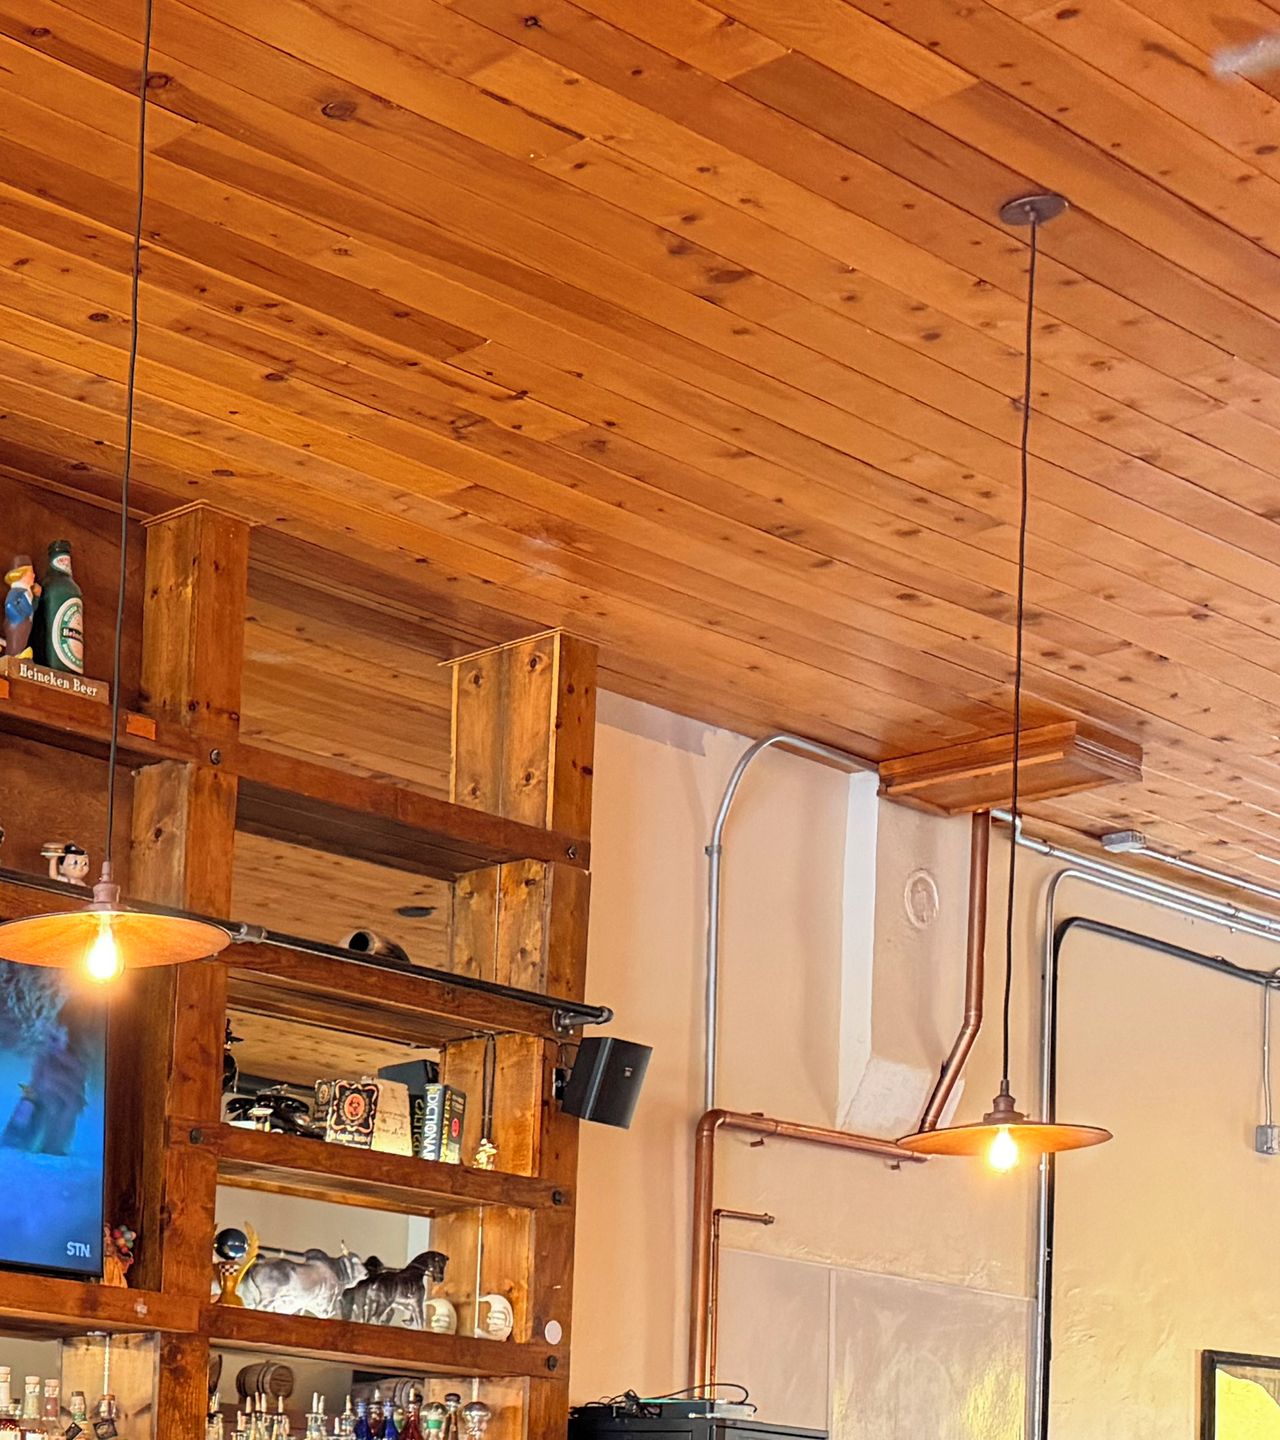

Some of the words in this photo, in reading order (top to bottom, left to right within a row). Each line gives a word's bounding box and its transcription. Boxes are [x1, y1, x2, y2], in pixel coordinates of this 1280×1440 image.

[20, 663, 70, 689] Heineken
[72, 678, 98, 696] Beer
[423, 1091, 439, 1160] DICTIONAR
